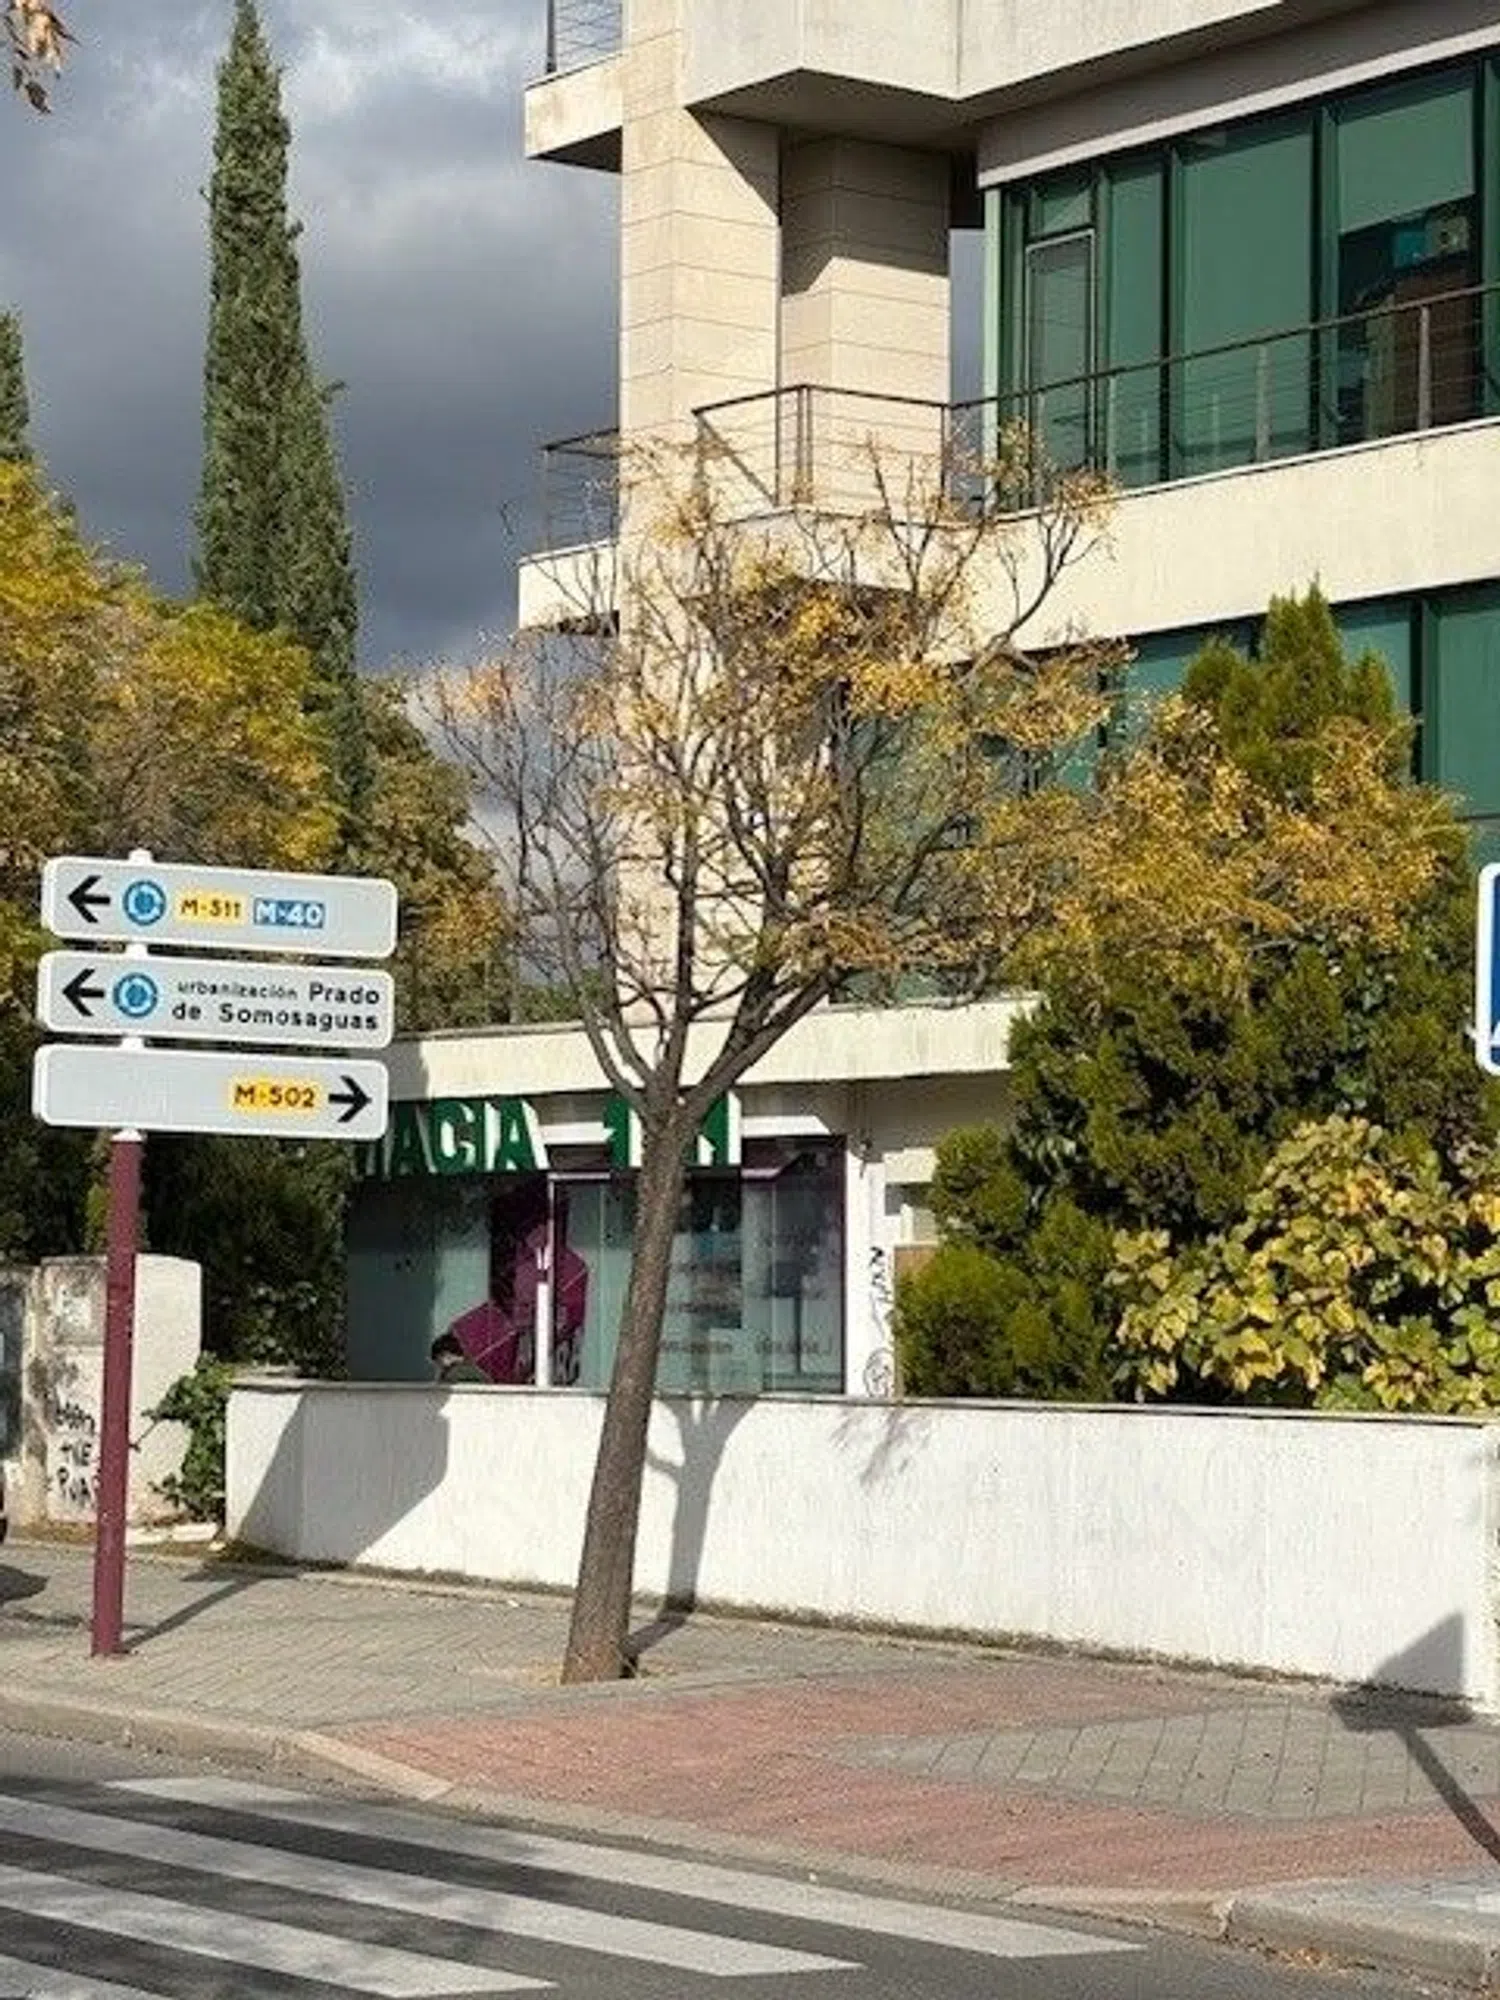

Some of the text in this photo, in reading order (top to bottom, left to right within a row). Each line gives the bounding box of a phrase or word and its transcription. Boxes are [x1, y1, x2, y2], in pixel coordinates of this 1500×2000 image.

[181, 897, 321, 925] M-511 M-40
[178, 980, 380, 1005] urbanización Prado
[172, 1002, 379, 1032] de Somosaguas
[234, 1084, 315, 1108] M-502
